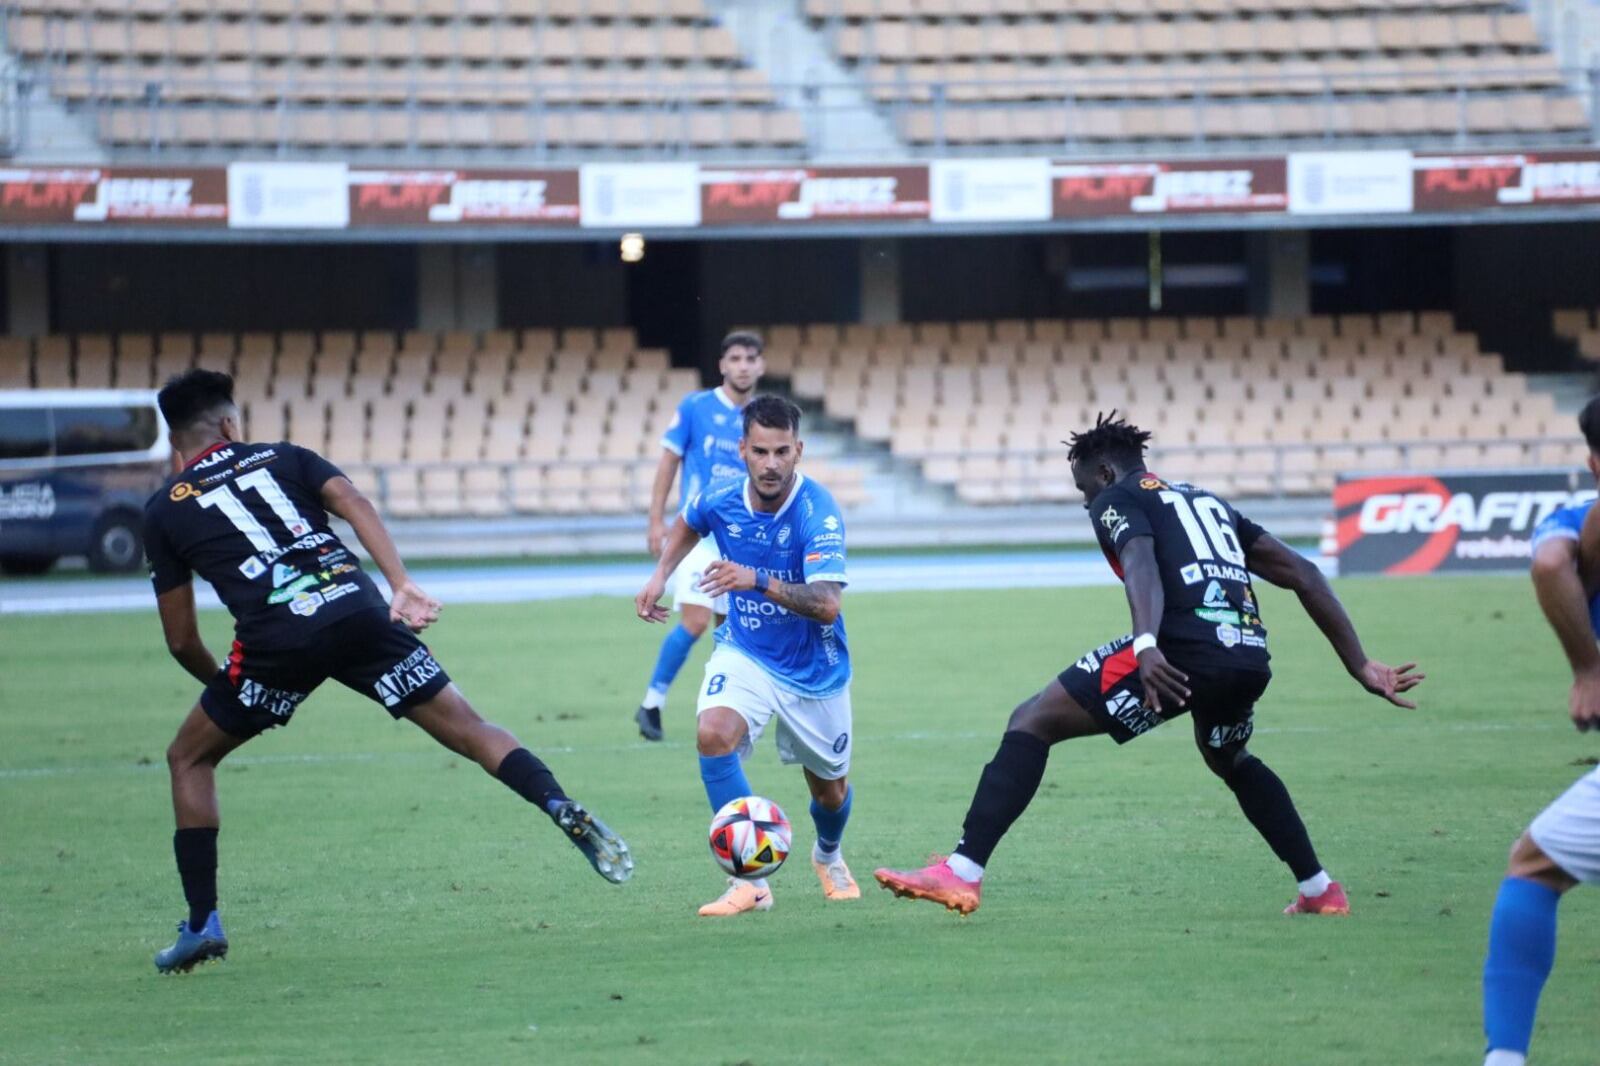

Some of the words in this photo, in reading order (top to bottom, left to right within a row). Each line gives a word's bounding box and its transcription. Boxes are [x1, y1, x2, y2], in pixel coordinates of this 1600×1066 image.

[196, 467, 313, 552] 11
[1158, 490, 1246, 567] 16
[707, 674, 726, 696] 8
